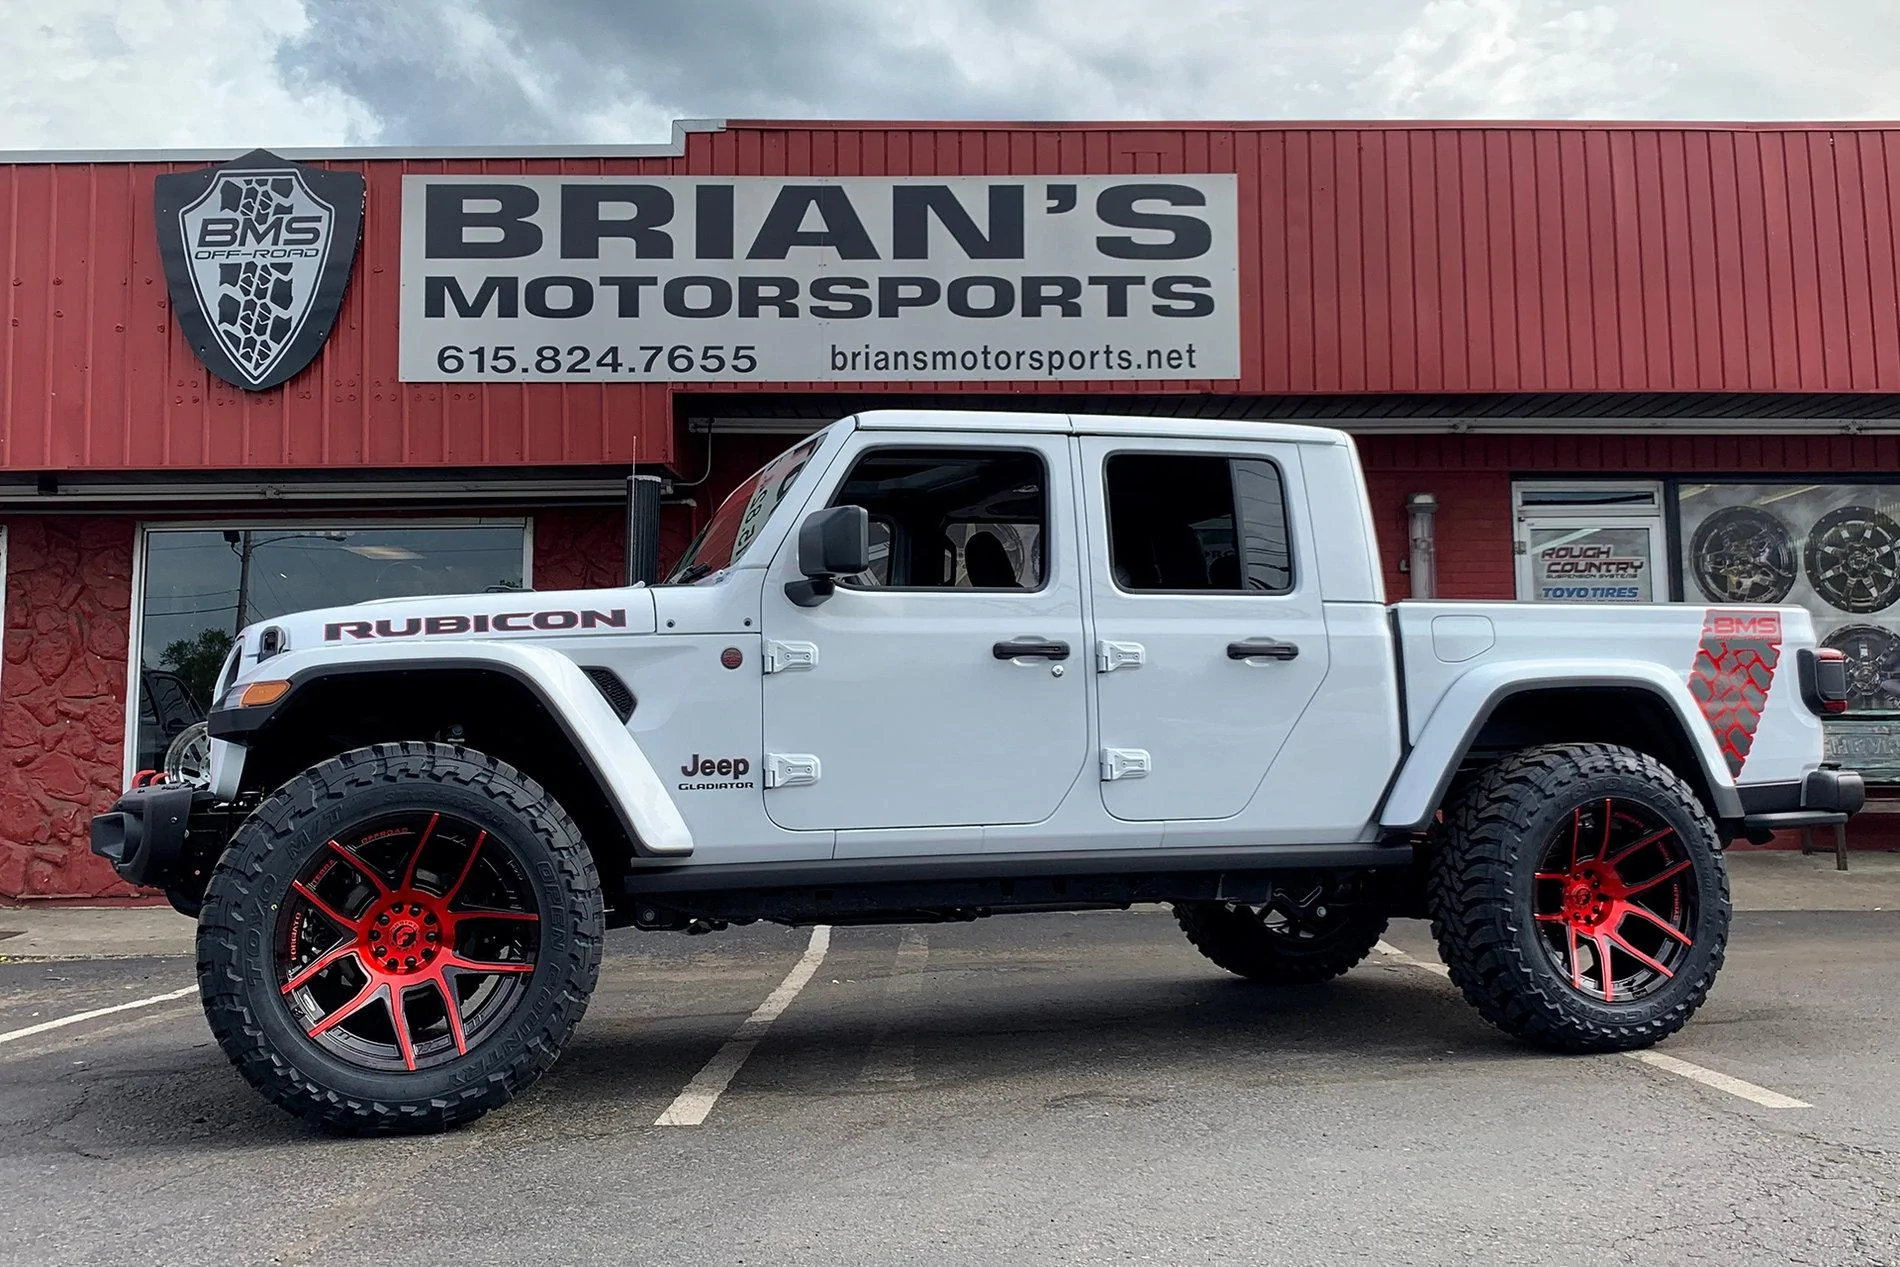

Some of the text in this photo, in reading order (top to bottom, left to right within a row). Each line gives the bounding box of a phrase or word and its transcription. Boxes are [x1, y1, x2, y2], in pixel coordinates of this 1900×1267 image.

[197, 215, 322, 248] BMS
[425, 183, 1212, 261] BRIAN'S
[194, 248, 319, 260] OFF-ROAD
[425, 276, 1215, 319] MOTORSPORTS
[436, 344, 758, 374] 615.824.7655
[830, 343, 1196, 376] briansmotorsports.net
[1541, 546, 1611, 559] ROUGH
[1547, 561, 1644, 574] COUNTRY
[1542, 587, 1639, 598] TOYO TIRES
[324, 609, 627, 642] RUBICON
[1714, 616, 1778, 634] BMS
[681, 754, 750, 780] Jeep
[678, 781, 754, 791] GLADIATOR
